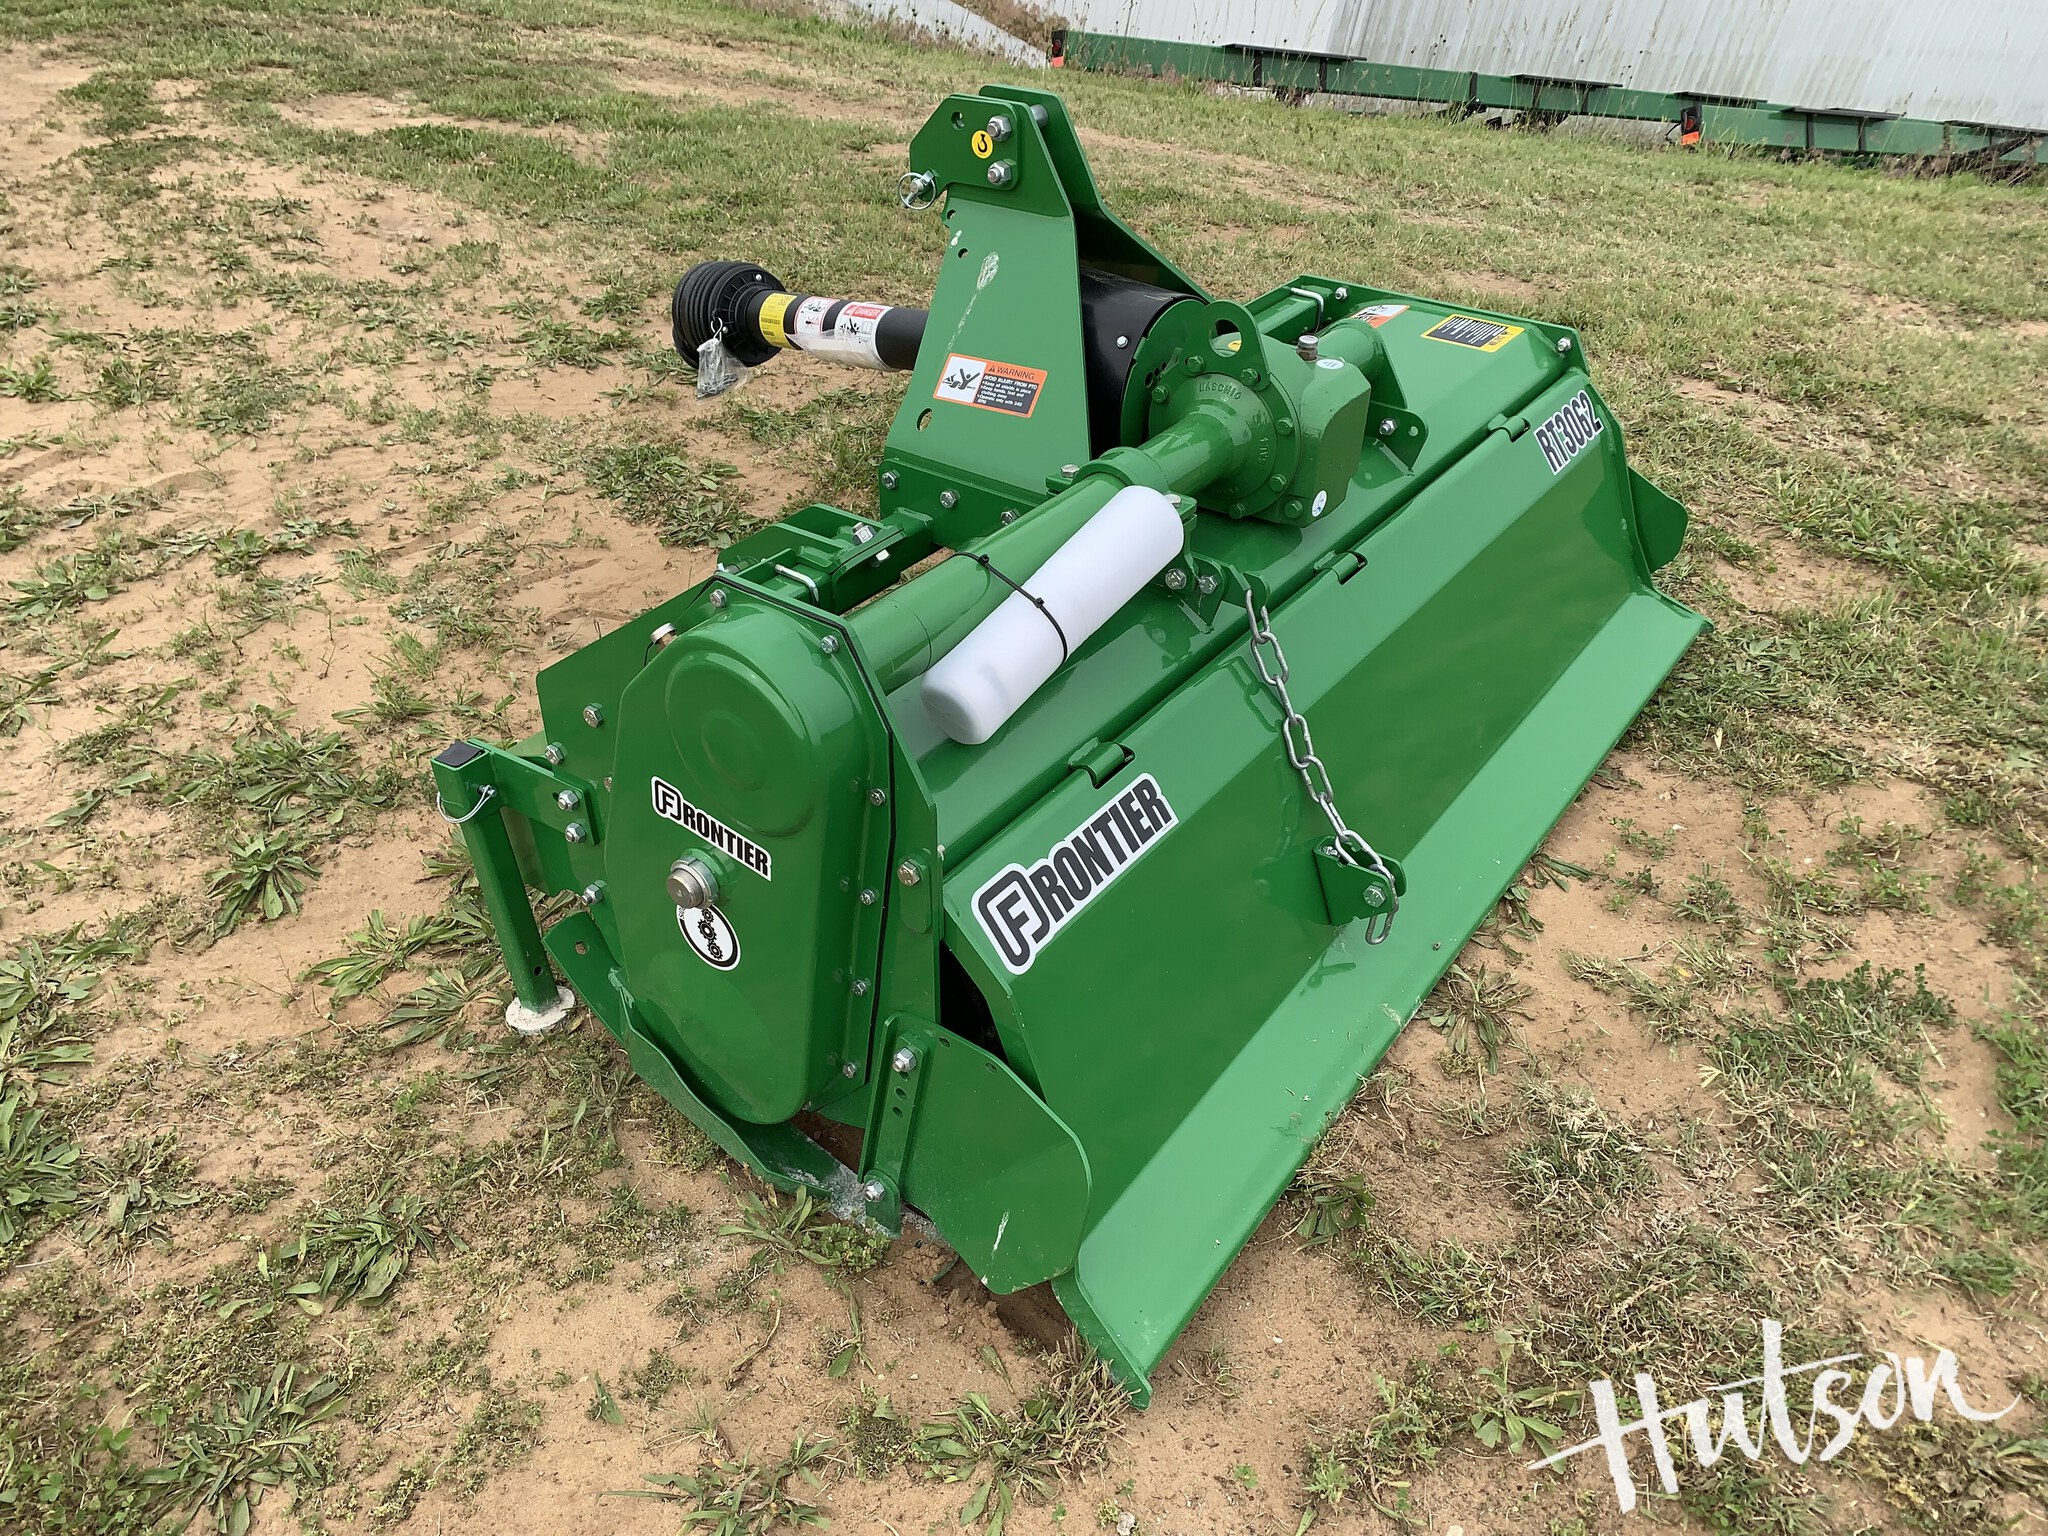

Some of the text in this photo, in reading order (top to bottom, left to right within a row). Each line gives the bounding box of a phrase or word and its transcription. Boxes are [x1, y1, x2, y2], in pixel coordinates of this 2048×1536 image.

[997, 366, 1035, 380] WARNING
[998, 377, 1013, 385] INJURY
[1014, 380, 1028, 388] FROM
[1199, 382, 1243, 400] MASCHIO
[1535, 392, 1603, 473] RT3062
[655, 779, 769, 877] FRONTIER
[977, 778, 1173, 967] FRONTIER
